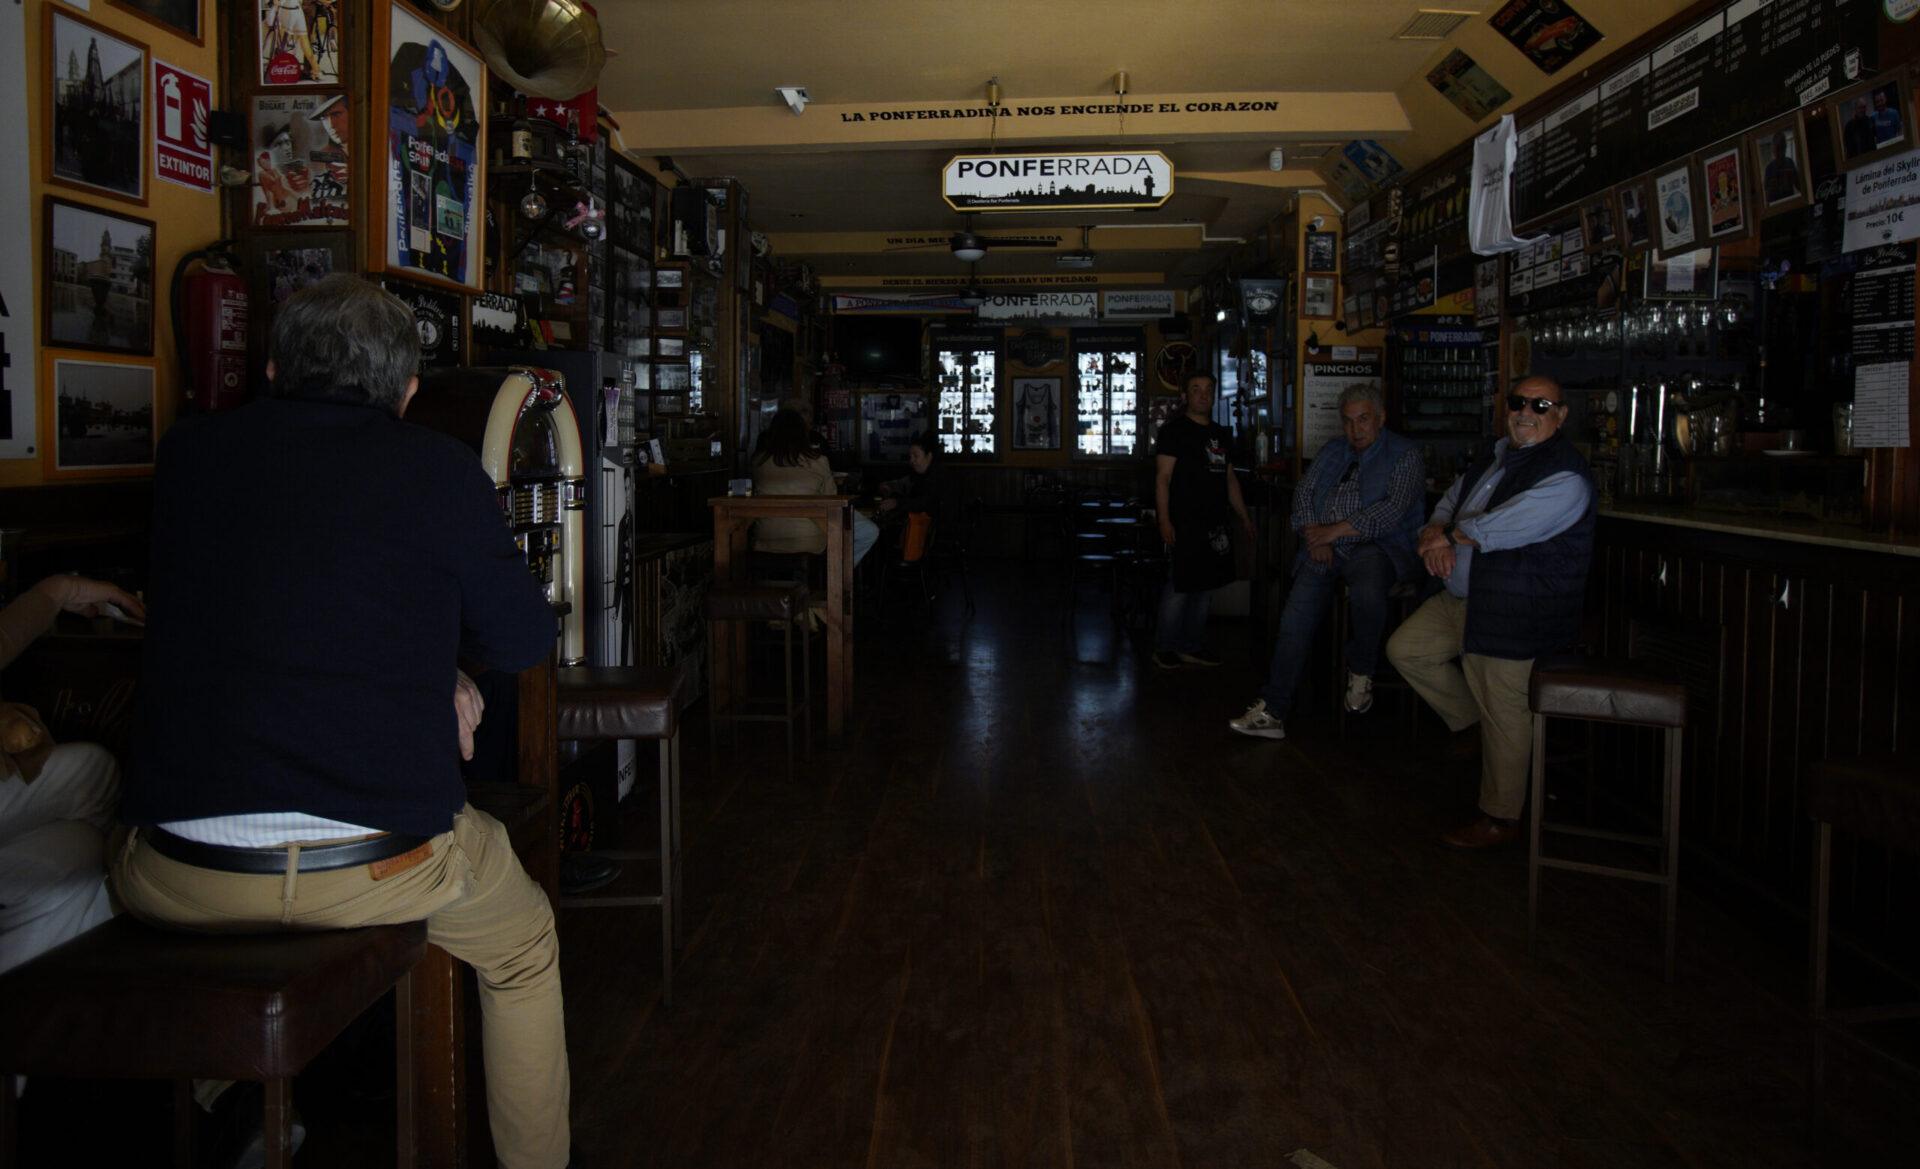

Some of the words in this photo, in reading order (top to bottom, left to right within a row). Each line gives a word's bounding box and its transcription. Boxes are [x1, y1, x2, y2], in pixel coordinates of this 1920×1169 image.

[841, 112, 866, 122] LA
[870, 106, 1012, 121] PONFERRADINA
[1017, 105, 1056, 116] NOS
[1060, 103, 1154, 115] ENCIENDE
[1159, 103, 1180, 113] EL
[1186, 101, 1279, 112] CORAZON
[158, 153, 210, 182] EXTINTOR
[958, 157, 1153, 178] PONFERRADA
[1873, 171, 1918, 191] Ponferrada
[1887, 211, 1905, 224] 10€
[983, 293, 1095, 307] PONFERRADA
[1108, 294, 1172, 304] PONFERRADA
[1314, 364, 1374, 375] PINCHOS
